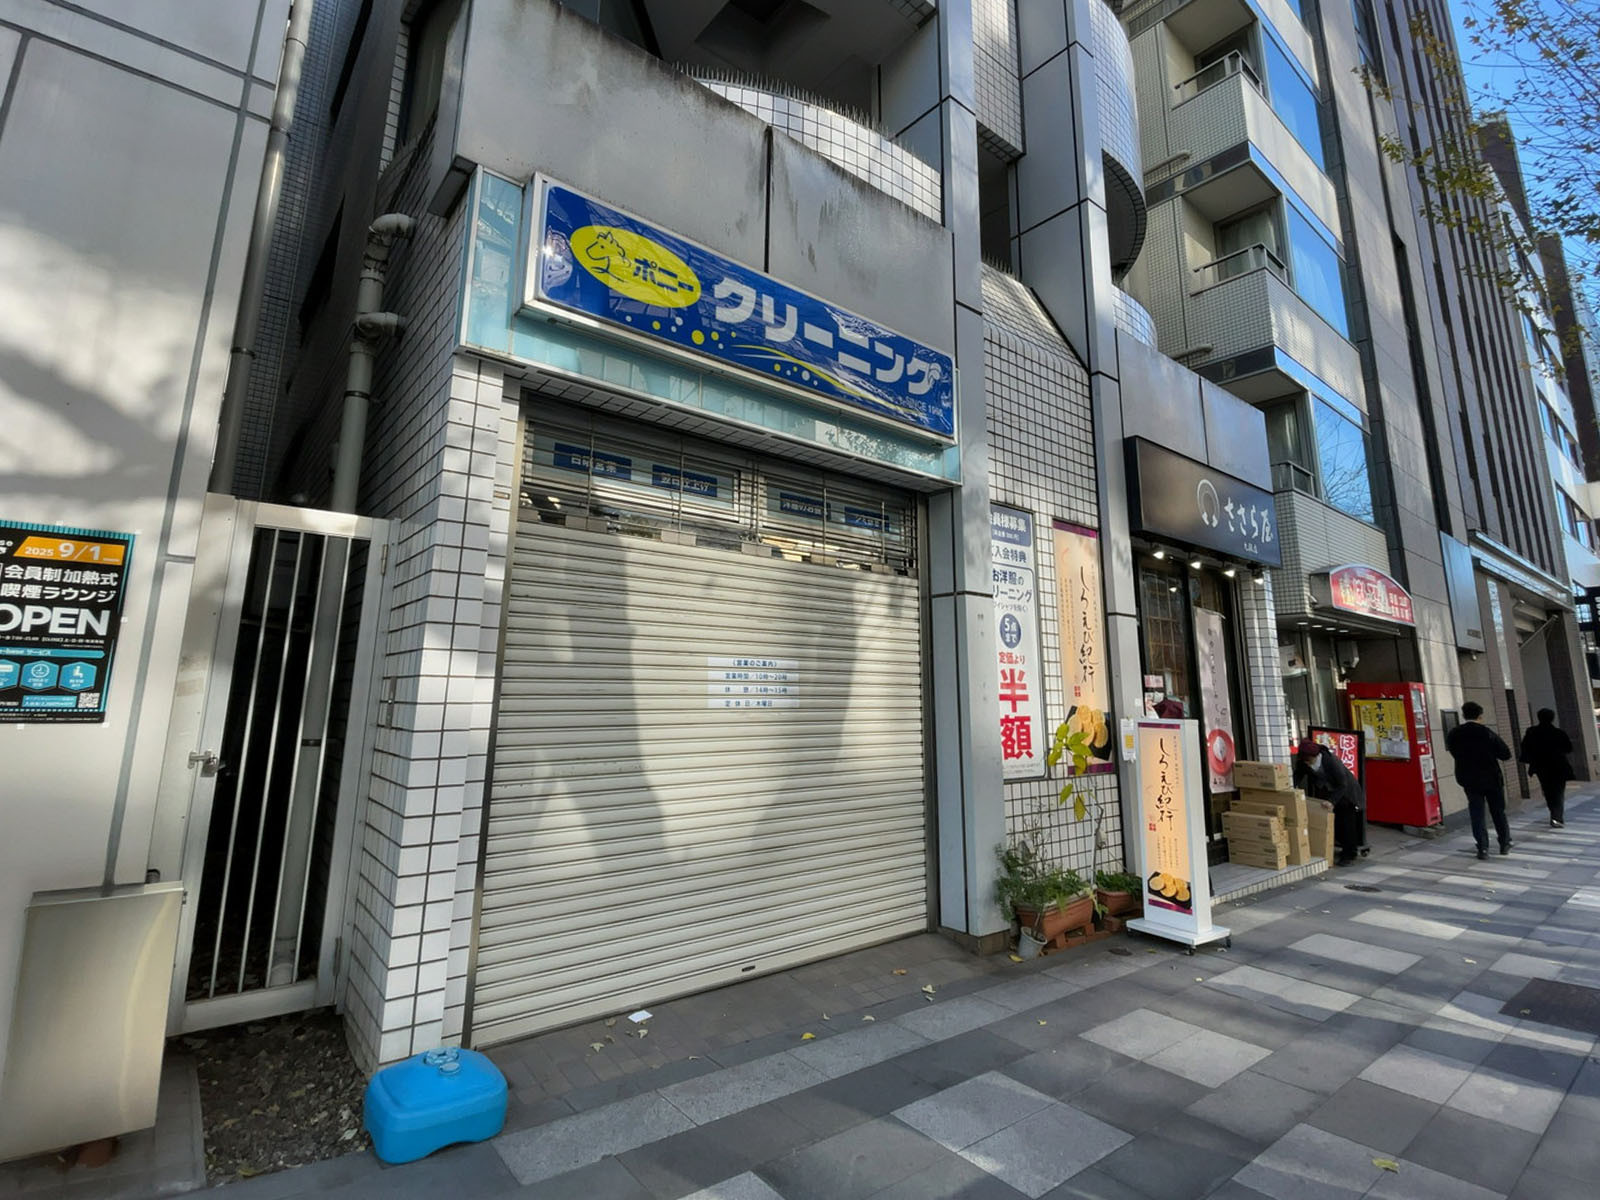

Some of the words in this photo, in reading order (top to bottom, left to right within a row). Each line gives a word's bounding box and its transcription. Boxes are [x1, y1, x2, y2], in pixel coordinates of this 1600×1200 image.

[634, 257, 694, 293] ポニー
[713, 277, 942, 395] クリーニング
[1224, 497, 1273, 543] ささら屋
[24, 546, 54, 556] 2025
[59, 542, 101, 560] 9/1
[0, 583, 117, 603] 喫煙ラウンジ
[0, 603, 111, 636] OPEN
[998, 668, 1033, 760] 半額
